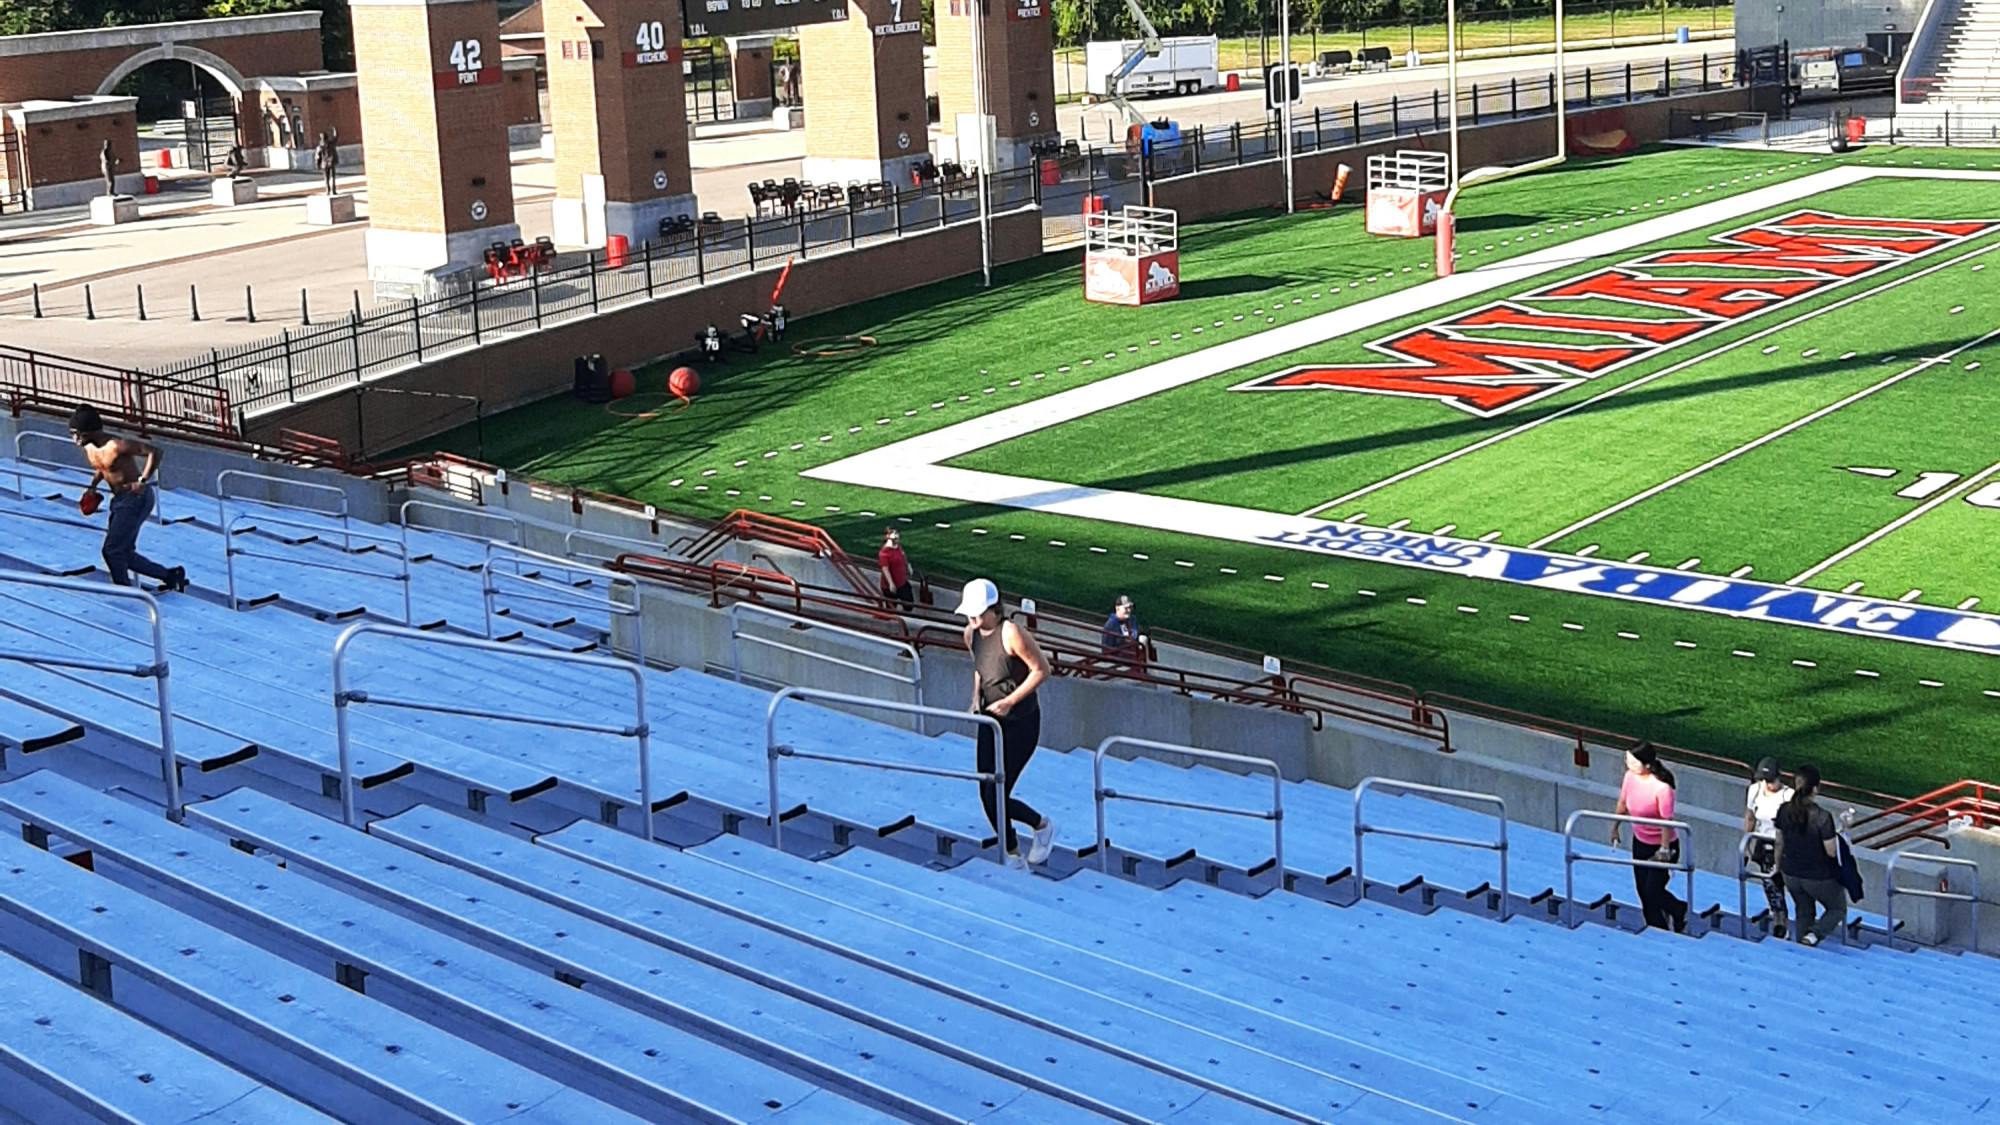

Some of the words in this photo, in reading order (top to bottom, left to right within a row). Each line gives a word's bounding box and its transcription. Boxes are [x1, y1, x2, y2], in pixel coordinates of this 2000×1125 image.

[890, 0, 902, 22] 7
[636, 21, 664, 51] 40
[450, 39, 482, 71] 42
[1228, 209, 2000, 418] MIAMI
[705, 338, 719, 351] 70
[1255, 531, 1473, 568] CREDIT
[1307, 524, 1492, 558] UNION
